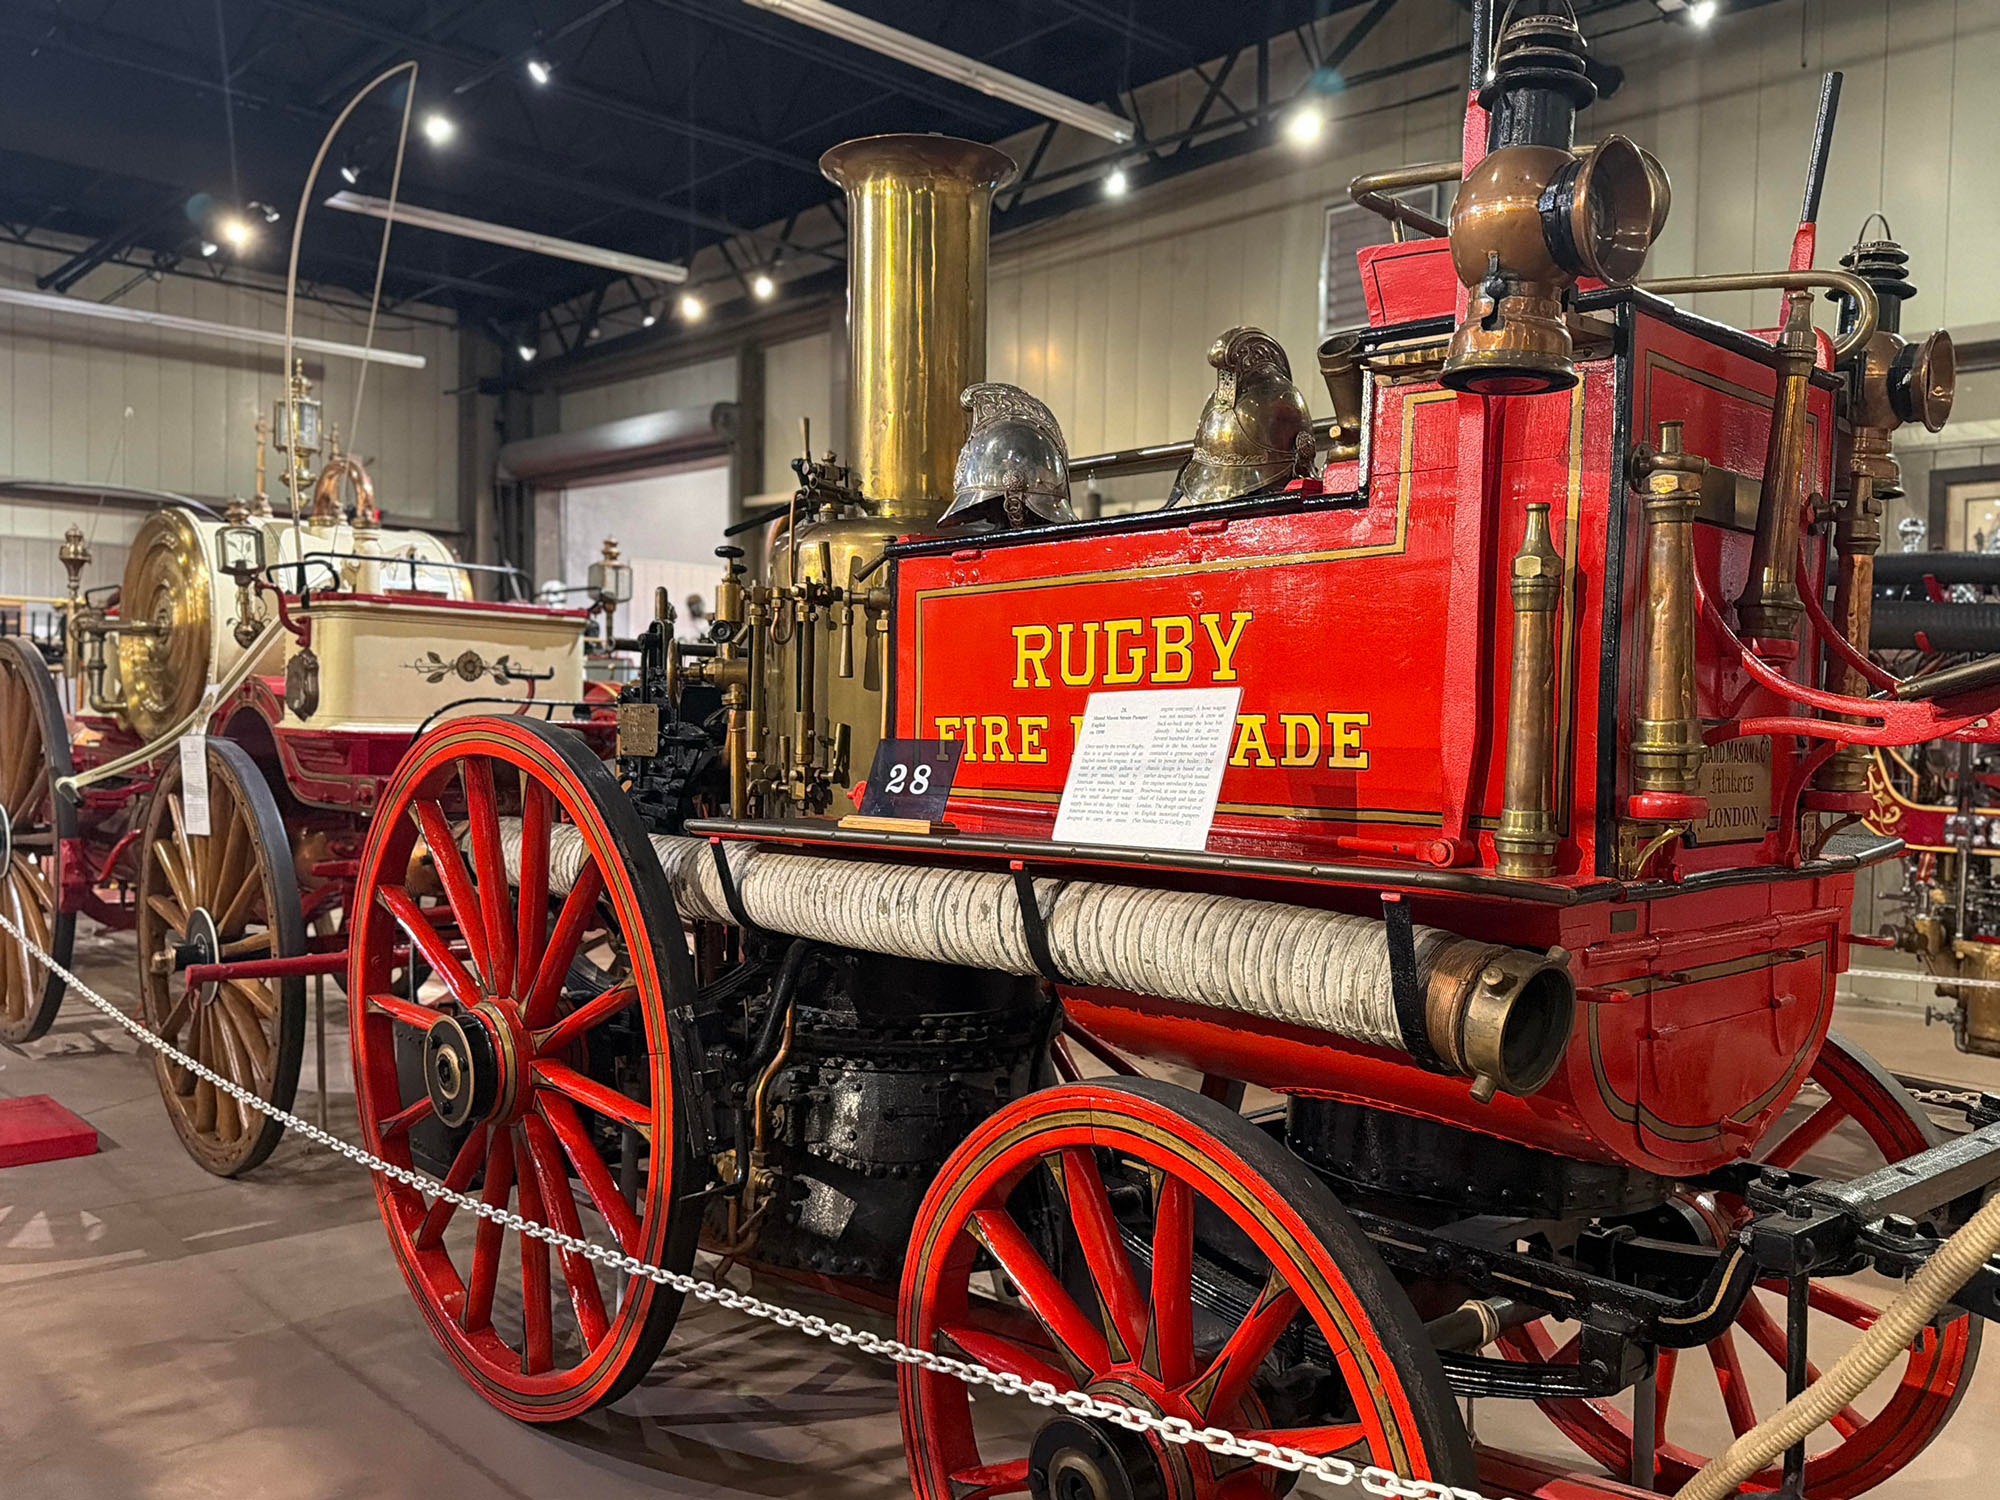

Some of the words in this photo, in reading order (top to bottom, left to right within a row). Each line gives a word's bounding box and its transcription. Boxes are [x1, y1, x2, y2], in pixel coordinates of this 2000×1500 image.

[1011, 610, 1253, 688] RUGBY
[934, 715, 1049, 763] FIRE
[1727, 741, 1754, 763] MASON
[885, 763, 932, 795] 28
[1709, 767, 1754, 794] Makers
[1705, 806, 1759, 829] LONDON
